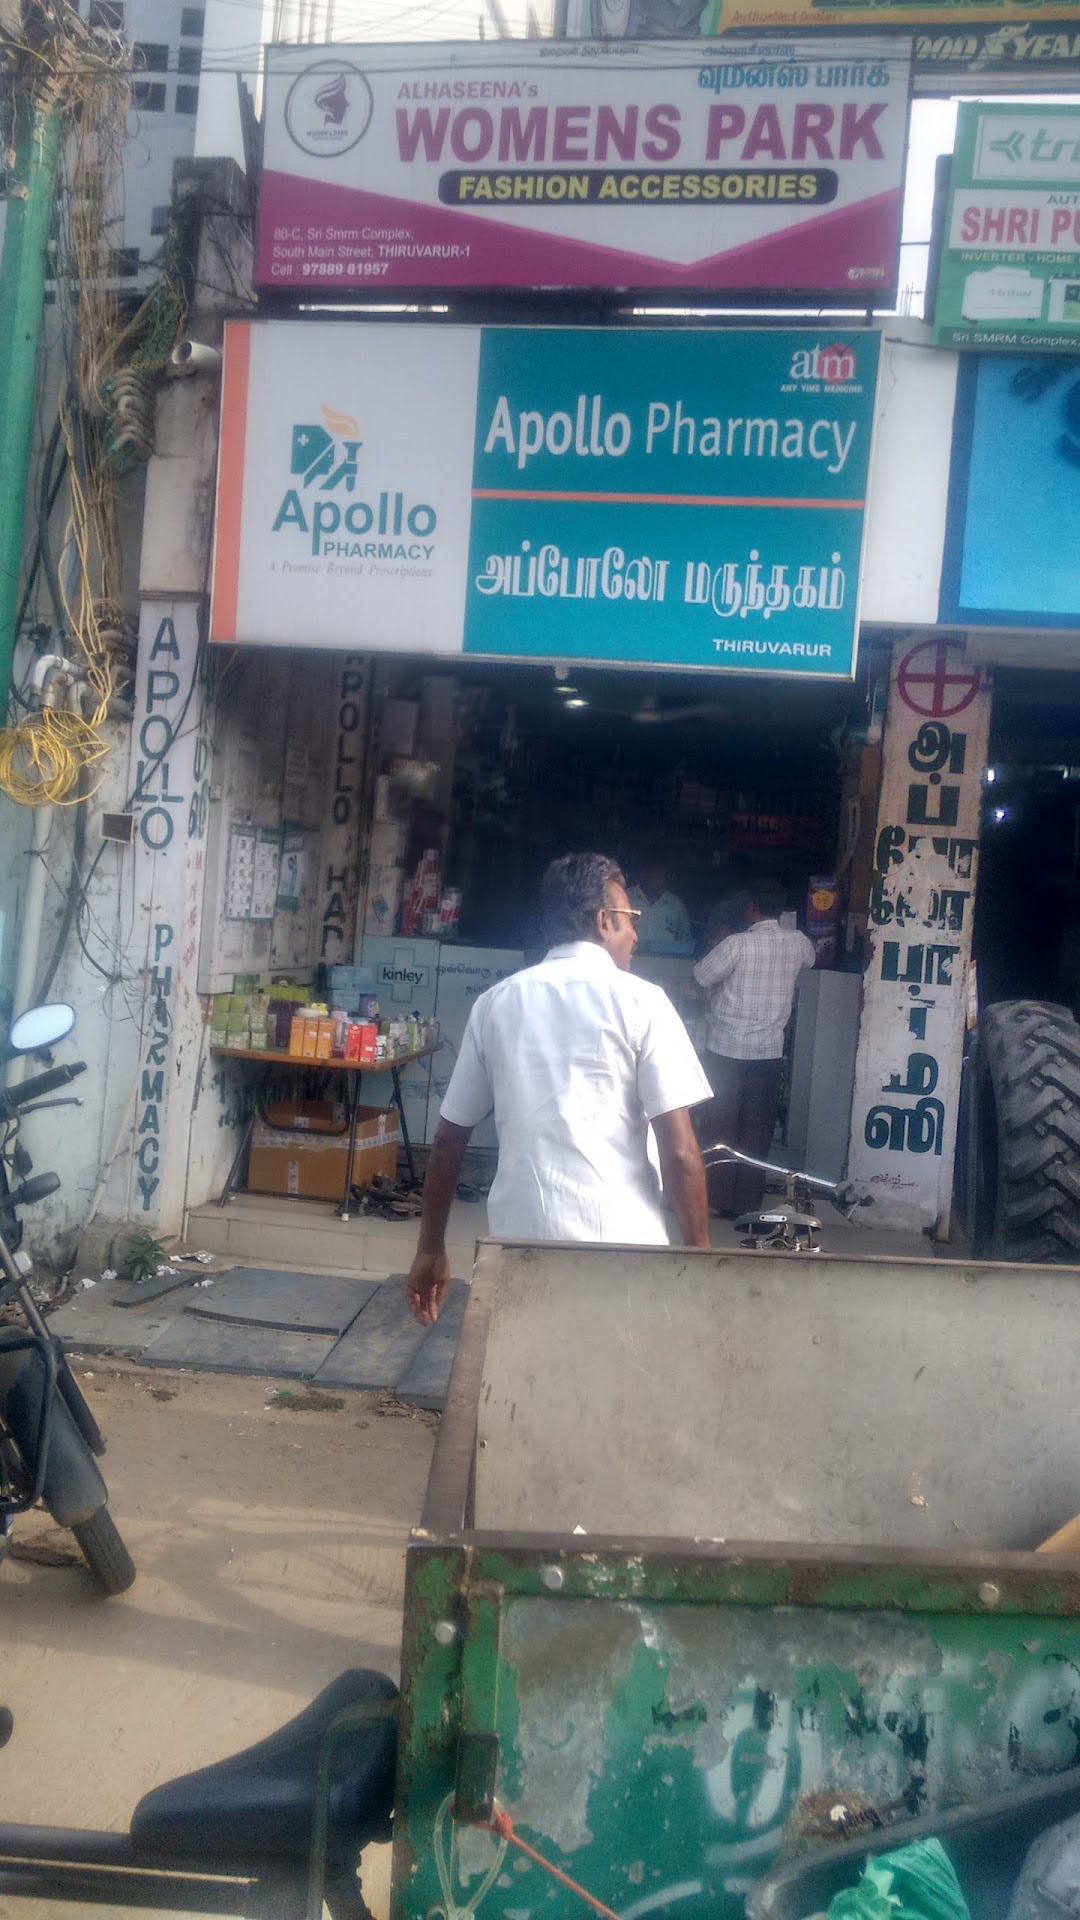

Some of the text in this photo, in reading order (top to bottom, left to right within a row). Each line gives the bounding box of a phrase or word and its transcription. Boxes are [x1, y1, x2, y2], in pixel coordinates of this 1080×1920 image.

[697, 57, 890, 95] வுமன்ஸ் பார்க்
[397, 79, 539, 101] ALHASEENA's
[395, 101, 890, 163] WOMENS PARK
[458, 174, 818, 200] FASHION ACCESSORIES
[307, 227, 322, 240] Sri
[325, 227, 358, 240] Smrm
[362, 227, 414, 242] Complex,
[960, 206, 1040, 244] SHRI
[272, 245, 471, 259] South Main Street, THIRUVARUR-1
[961, 252, 1026, 262] INVERTER
[1037, 253, 1074, 263] HOME
[271, 263, 292, 276] Cell
[302, 262, 343, 276] 97889
[347, 262, 389, 276] 81957
[952, 332, 969, 342] Sri
[973, 333, 1017, 343] SMRM
[789, 343, 856, 380] atm
[780, 384, 863, 394] ANY TIME MEDICINE
[484, 394, 857, 474] Apollo Pharmacy
[271, 489, 437, 556] Apollo
[323, 542, 435, 560] PHARMACY
[281, 561, 321, 574] Promise
[327, 561, 363, 577] Beyond
[369, 561, 433, 579] Prescriptions
[475, 540, 846, 619] அப்போலோ மருந்தகம்
[712, 638, 832, 657] THIRUVARUR
[134, 617, 185, 851] APOLLO
[381, 965, 424, 983] kinley
[138, 923, 174, 1212] PHARMACY
